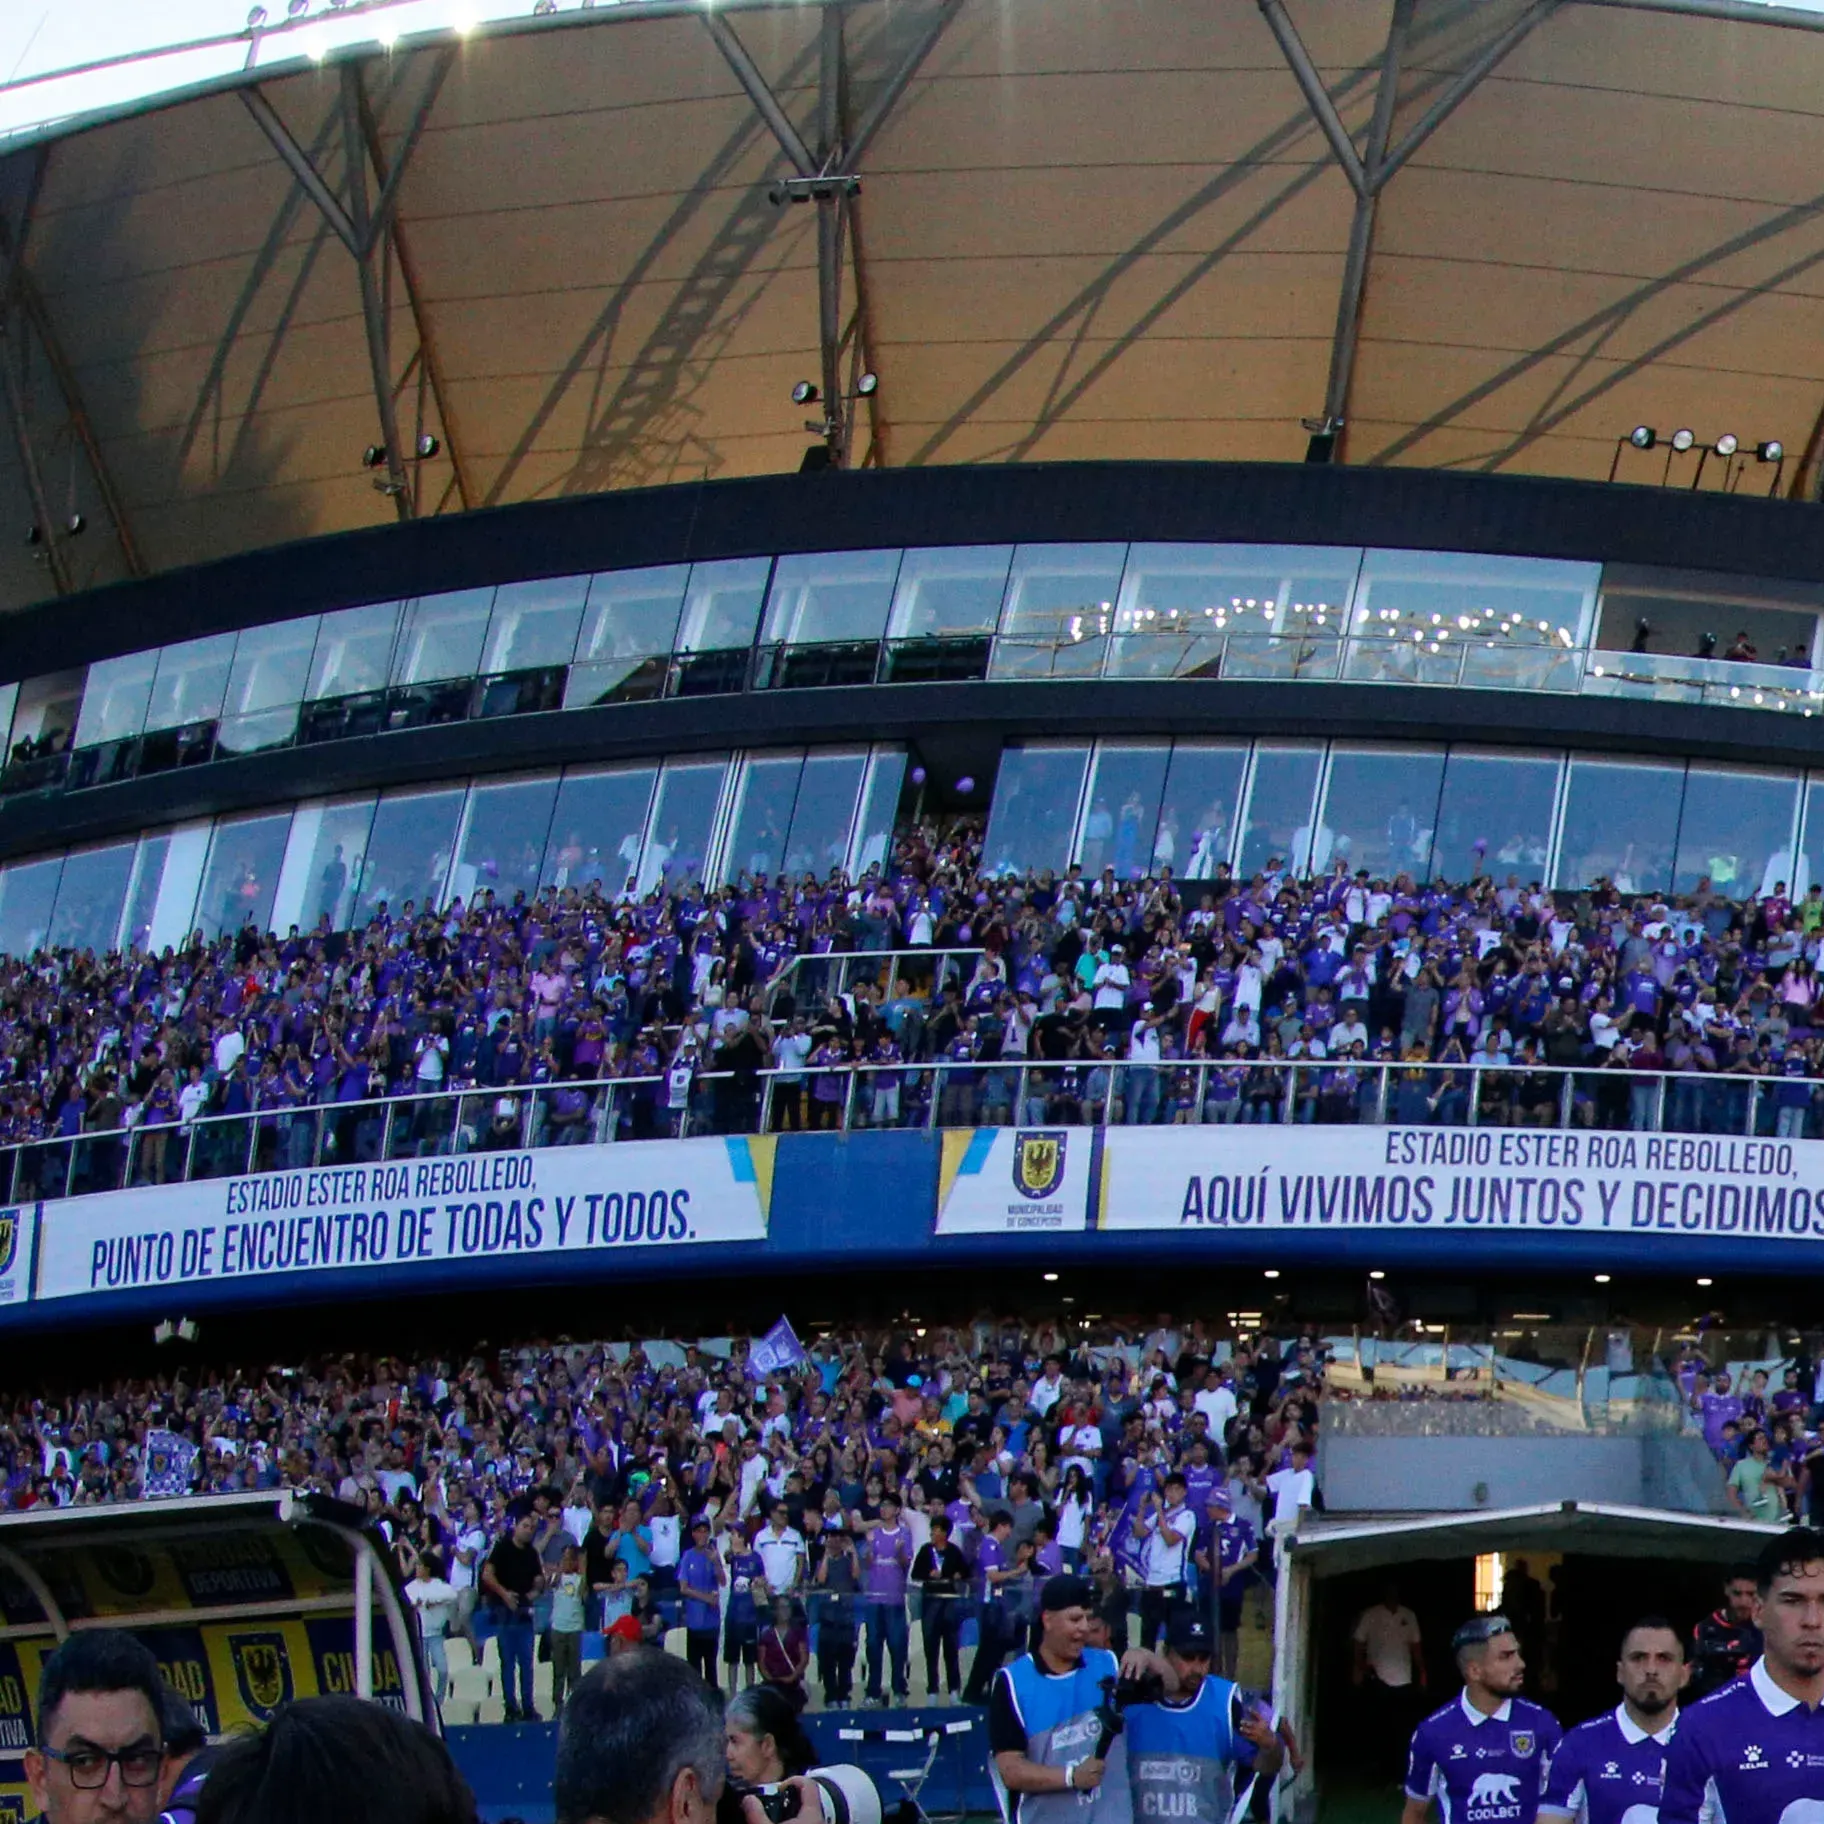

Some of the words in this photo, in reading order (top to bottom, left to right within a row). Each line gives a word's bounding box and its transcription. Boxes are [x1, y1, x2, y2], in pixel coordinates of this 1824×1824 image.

[1385, 1132, 1491, 1167] ESTADIO
[1500, 1133, 1579, 1168] ESTER
[1587, 1136, 1637, 1169] ROA
[1646, 1137, 1798, 1180] REBOLLEDO,
[226, 1175, 302, 1215] ESTADIO
[306, 1170, 367, 1207] ESTER
[371, 1166, 409, 1201] ROA
[415, 1155, 537, 1198] REBOLLEDO,
[1180, 1165, 1272, 1227] AQUÍ
[1280, 1175, 1436, 1225] VIVIMOS
[1444, 1176, 1586, 1227] JUNTOS
[1598, 1180, 1621, 1228] Y
[91, 1231, 175, 1289] PUNTO
[180, 1226, 217, 1278] DE
[222, 1210, 390, 1274] ENCUENTRO
[396, 1207, 437, 1259] DE
[445, 1198, 545, 1255] TODAS
[555, 1195, 577, 1247] Y
[584, 1188, 697, 1245] TODOS.
[1739, 1760, 1770, 1770] KELME
[1143, 1792, 1198, 1815] CLUB
[1467, 1805, 1521, 1821] COOLBET
